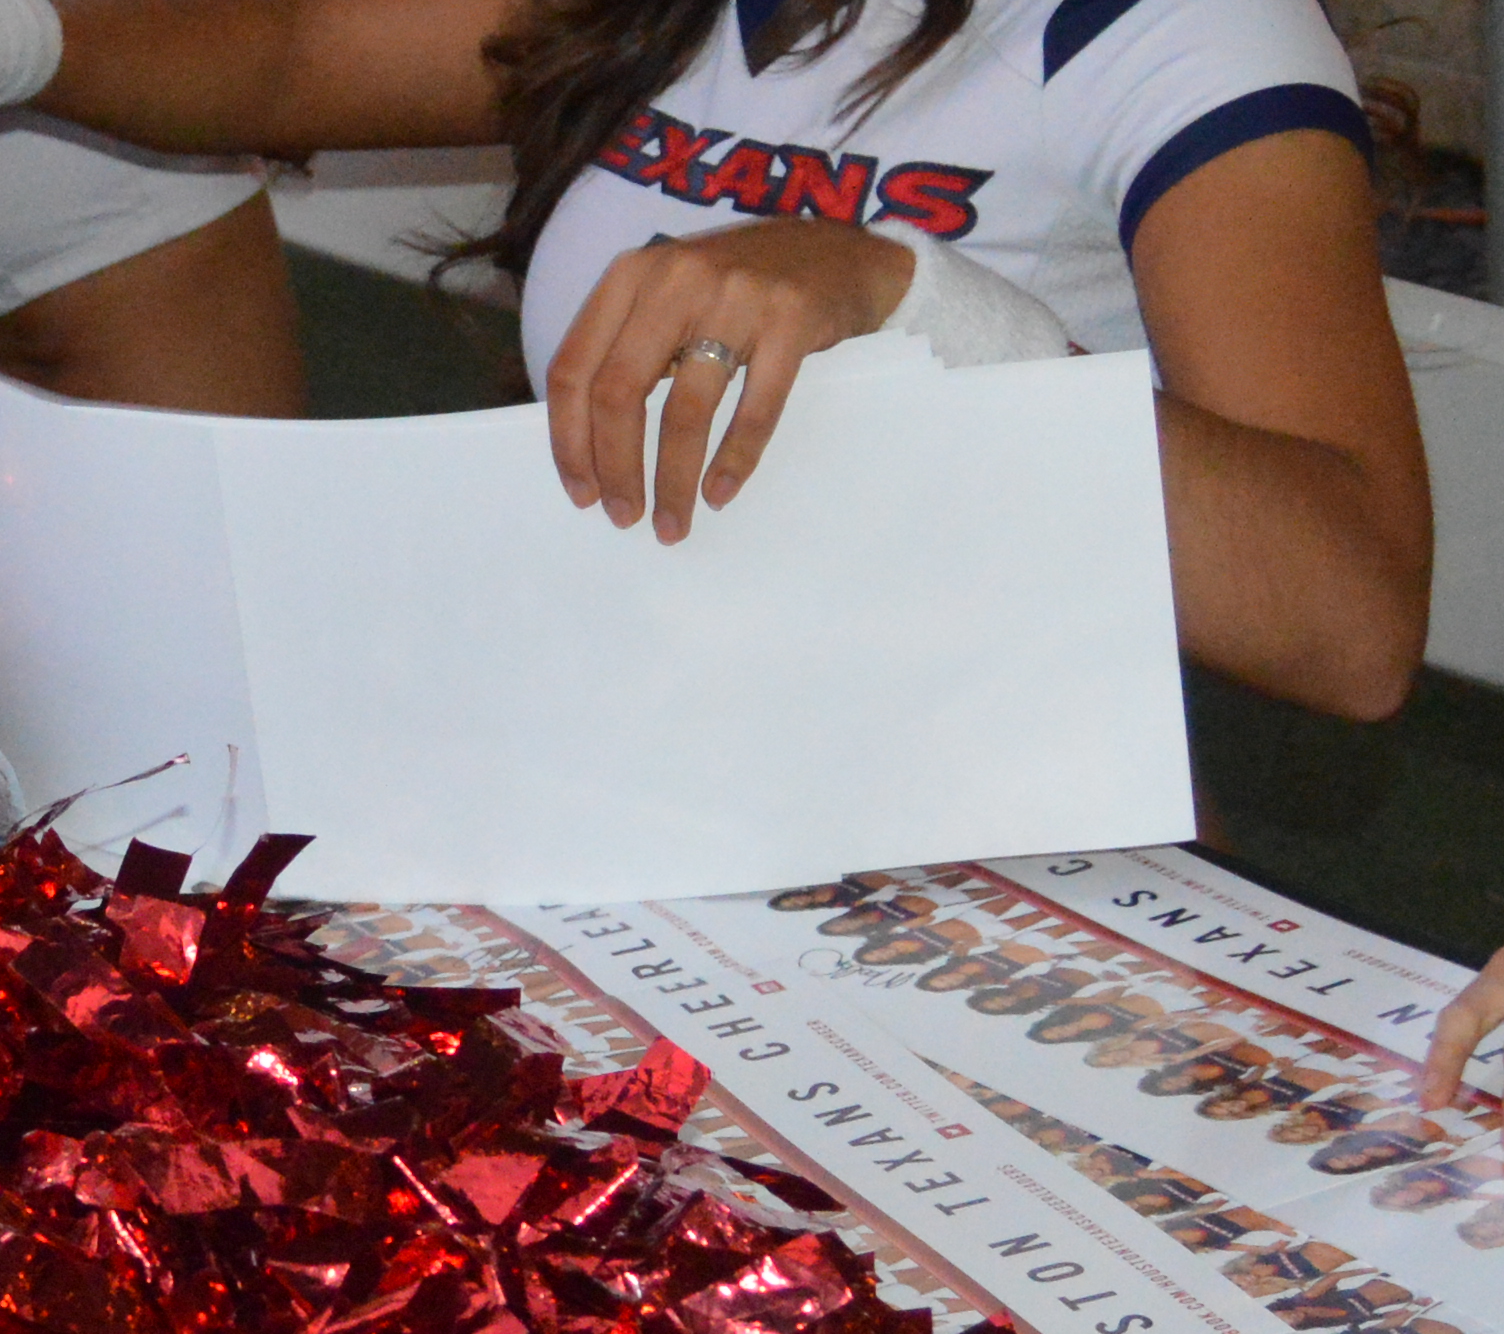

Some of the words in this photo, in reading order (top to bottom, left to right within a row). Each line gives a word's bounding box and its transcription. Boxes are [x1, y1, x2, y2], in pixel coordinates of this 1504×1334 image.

[592, 105, 994, 241] EXANS
[1112, 889, 1356, 996] TEXANS
[786, 1081, 992, 1217] TEXANS
